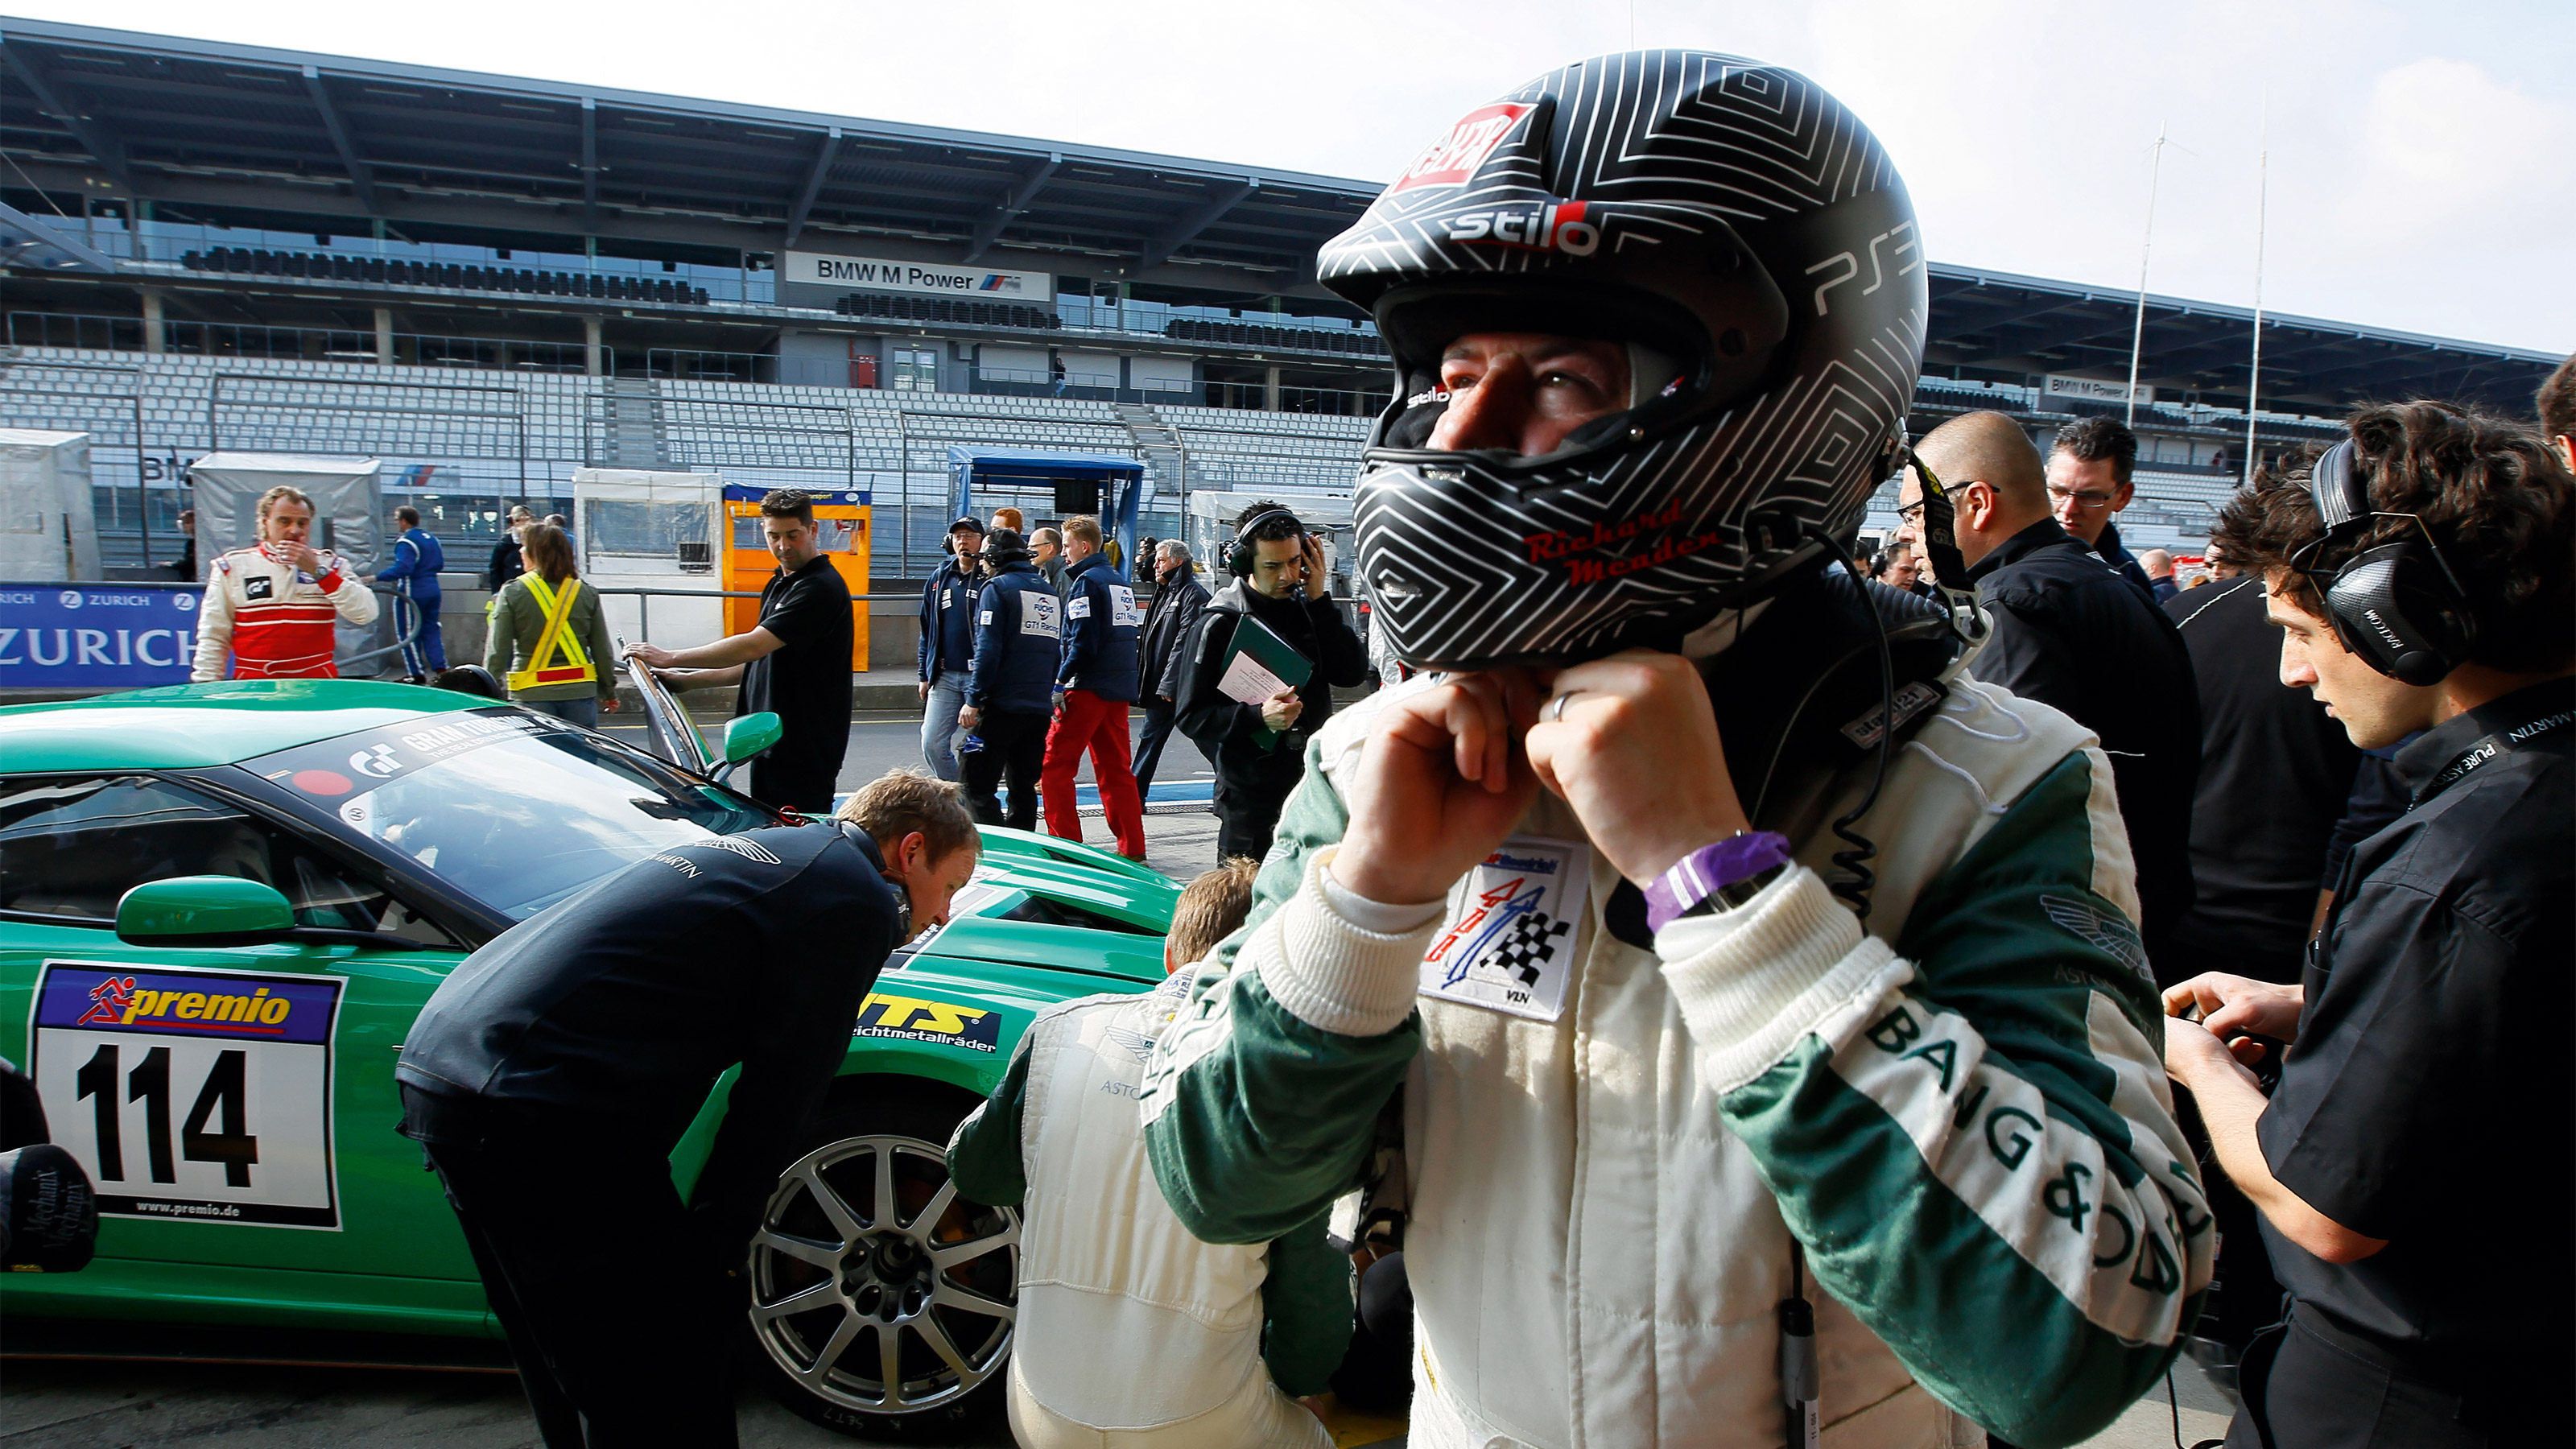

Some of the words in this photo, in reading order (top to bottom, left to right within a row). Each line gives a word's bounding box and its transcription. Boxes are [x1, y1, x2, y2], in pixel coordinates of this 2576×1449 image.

[1450, 204, 1600, 256] stilo
[818, 259, 876, 282] BMW
[882, 265, 900, 284] M
[909, 267, 973, 290] Power
[1805, 220, 1920, 316] PS3
[1407, 386, 1450, 409] stilo
[2094, 383, 2124, 398] Power
[143, 457, 200, 481] BM
[1524, 497, 1684, 565] Richard
[1563, 531, 1724, 587] Meaden
[89, 595, 151, 606] ZURICH
[1034, 604, 1054, 613] FUCHS
[1026, 621, 1039, 629] GT1
[1041, 622, 1059, 635] Racing
[0, 628, 198, 667] ZURICH
[402, 724, 470, 752] GRAN
[2508, 712, 2571, 742] MARTIN
[2465, 742, 2496, 770] PURE
[121, 988, 291, 1025] premio
[852, 1026, 997, 1053] eichtmetallräder
[1100, 1080, 1141, 1101] ASTO
[1864, 1005, 2043, 1172] BANG
[76, 1043, 259, 1189] 114
[136, 1202, 241, 1217] www.premio.de
